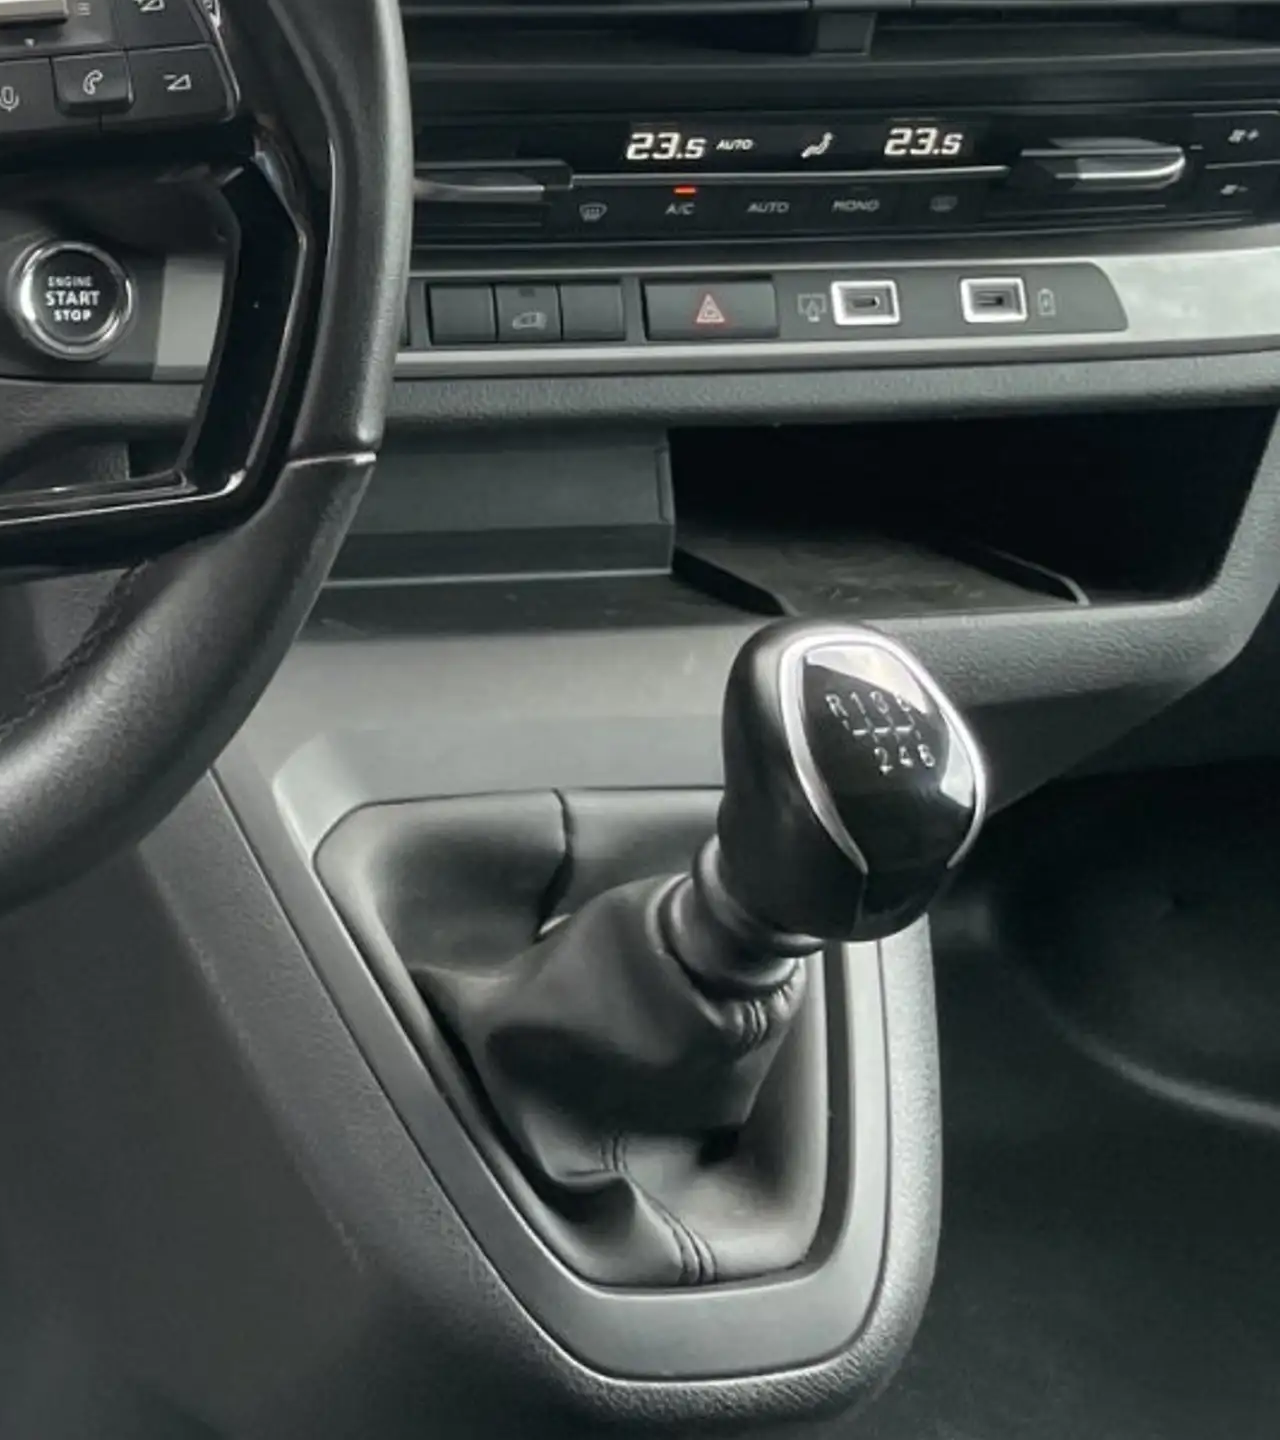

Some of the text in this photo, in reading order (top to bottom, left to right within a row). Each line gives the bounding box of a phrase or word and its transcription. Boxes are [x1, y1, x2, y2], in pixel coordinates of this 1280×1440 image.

[626, 131, 754, 160] 23.5 AUTO
[884, 127, 963, 156] 23.5
[665, 203, 694, 216] A/C
[747, 201, 790, 214] AUTO
[832, 199, 880, 212] MONO
[47, 275, 92, 287] ENGINE
[45, 290, 101, 306] START
[53, 309, 92, 322] STOP
